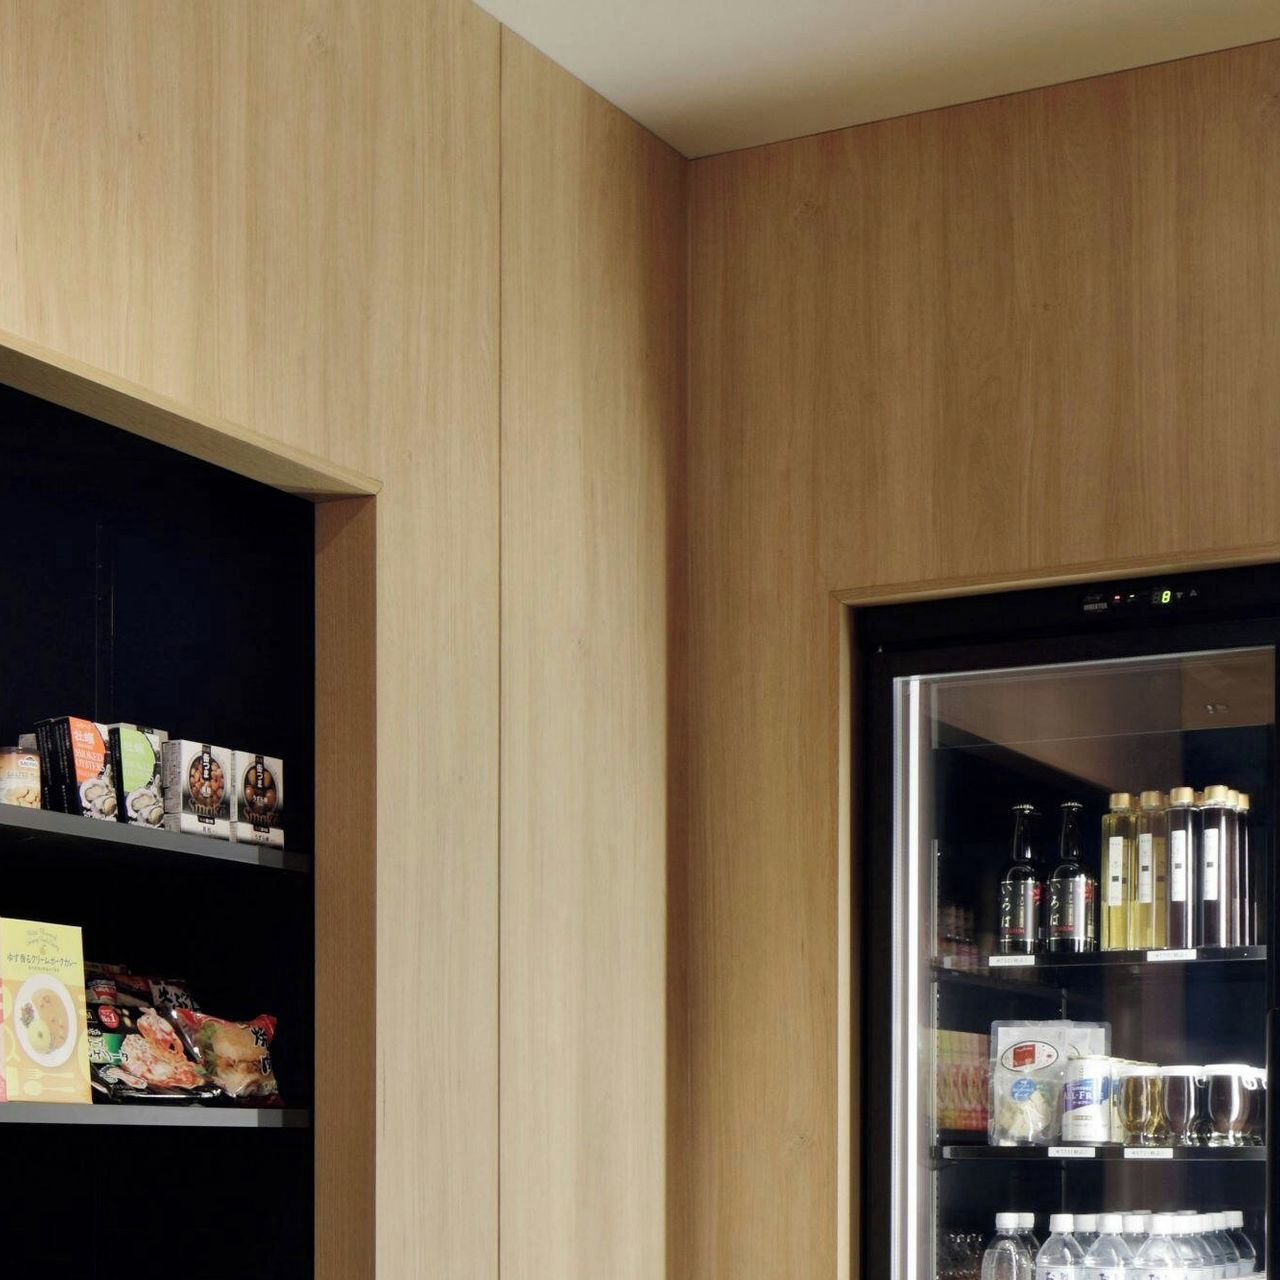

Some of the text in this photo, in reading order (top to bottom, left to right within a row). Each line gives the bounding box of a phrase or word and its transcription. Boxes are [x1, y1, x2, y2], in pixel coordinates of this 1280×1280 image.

[1160, 590, 1172, 604] 8
[1001, 885, 1012, 928] いろは
[1049, 883, 1061, 926] いろは
